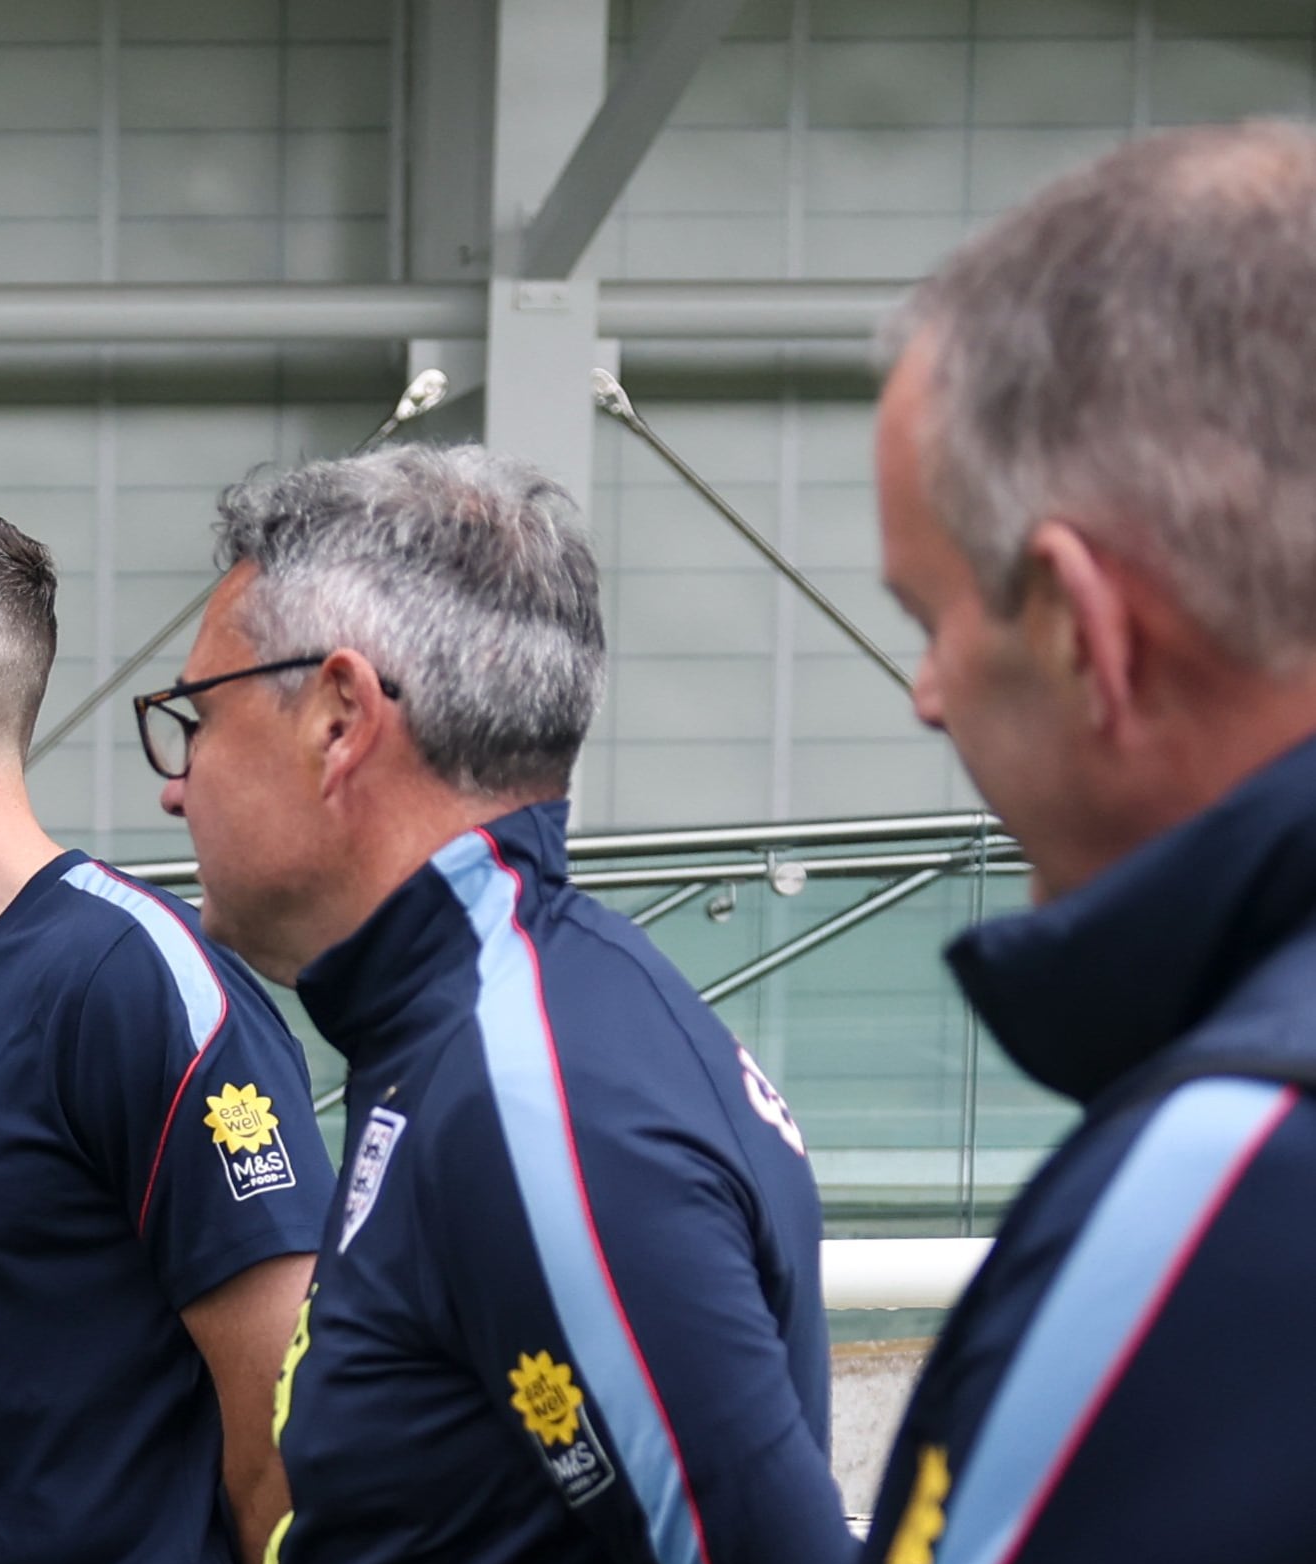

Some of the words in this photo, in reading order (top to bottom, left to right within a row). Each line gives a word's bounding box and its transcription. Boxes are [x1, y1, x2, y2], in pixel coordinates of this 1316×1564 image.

[219, 1099, 249, 1119] eat
[224, 1109, 263, 1132] well
[232, 1151, 284, 1181] M&S
[250, 1173, 279, 1187] FOOD
